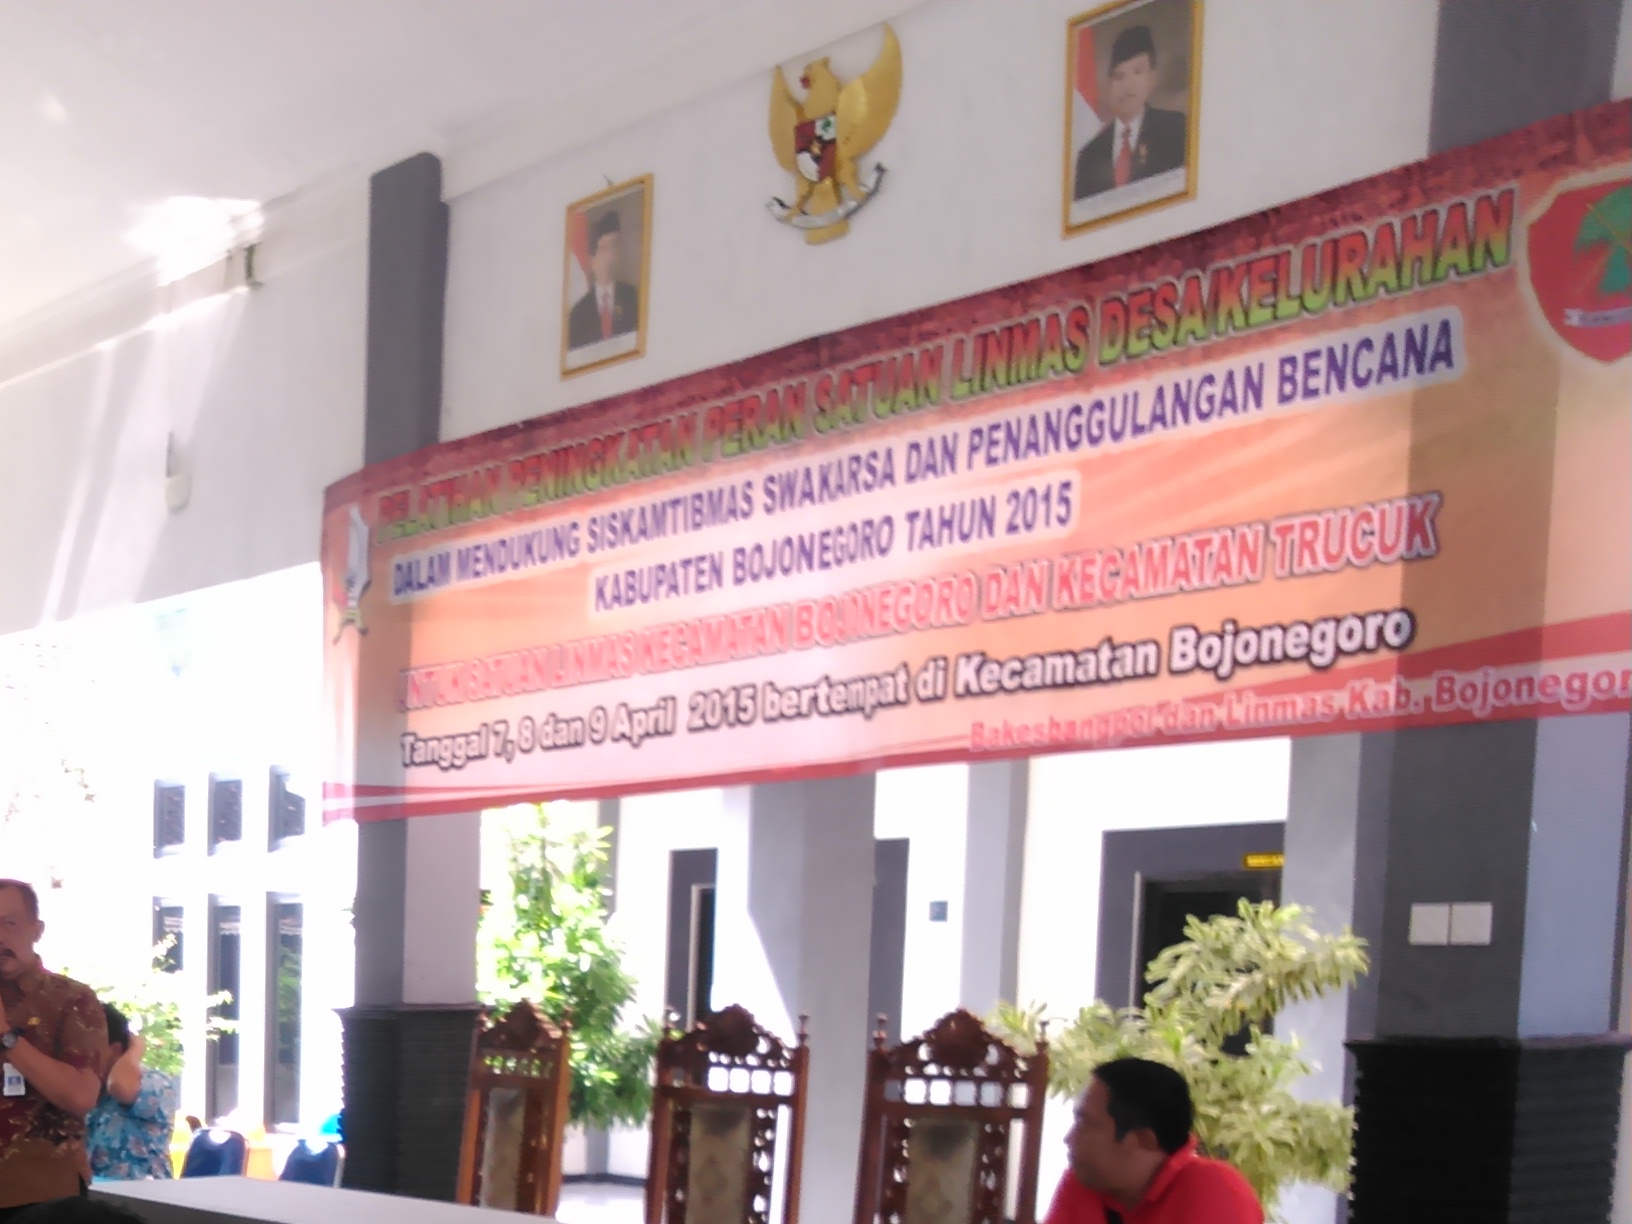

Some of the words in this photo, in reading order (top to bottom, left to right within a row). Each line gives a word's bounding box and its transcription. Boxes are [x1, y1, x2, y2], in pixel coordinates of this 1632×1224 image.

[394, 551, 451, 596] DALAM
[457, 521, 580, 581] MENDUKUNG
[587, 480, 753, 553] SISKAMTIBMAS
[763, 447, 895, 515] SWAKARSA
[905, 431, 959, 484] DAN
[967, 361, 1264, 471] PENANGGULANGAN
[1278, 318, 1455, 406] BENCANA
[702, 380, 806, 463] PERAN
[814, 347, 943, 433] SATUAN
[950, 305, 1090, 399] LINMAS
[550, 630, 635, 690] LINMAS
[636, 602, 790, 675] KECAMATAN
[981, 559, 1050, 620] DAN
[1052, 521, 1267, 611] KECAMATAN
[1270, 490, 1443, 579] TRUCUK
[595, 551, 724, 612] KABUPATEN
[733, 514, 894, 587] BOJONEGORO
[905, 495, 997, 551] TAHUN
[1006, 480, 1072, 535] 2015
[401, 721, 489, 771] Tanggal
[492, 719, 515, 762] 7,
[518, 715, 536, 753] 8
[540, 713, 584, 750] dan
[589, 706, 608, 744] 9
[611, 696, 677, 747] April
[687, 683, 756, 732] 2015
[762, 662, 910, 719] bertempat
[916, 656, 948, 702] di
[953, 636, 1161, 697] Kecamatan
[1168, 607, 1416, 680] Bojonegoro
[1162, 700, 1216, 734] dan
[1222, 689, 1337, 729] Linmas
[1345, 676, 1423, 719] Kab.
